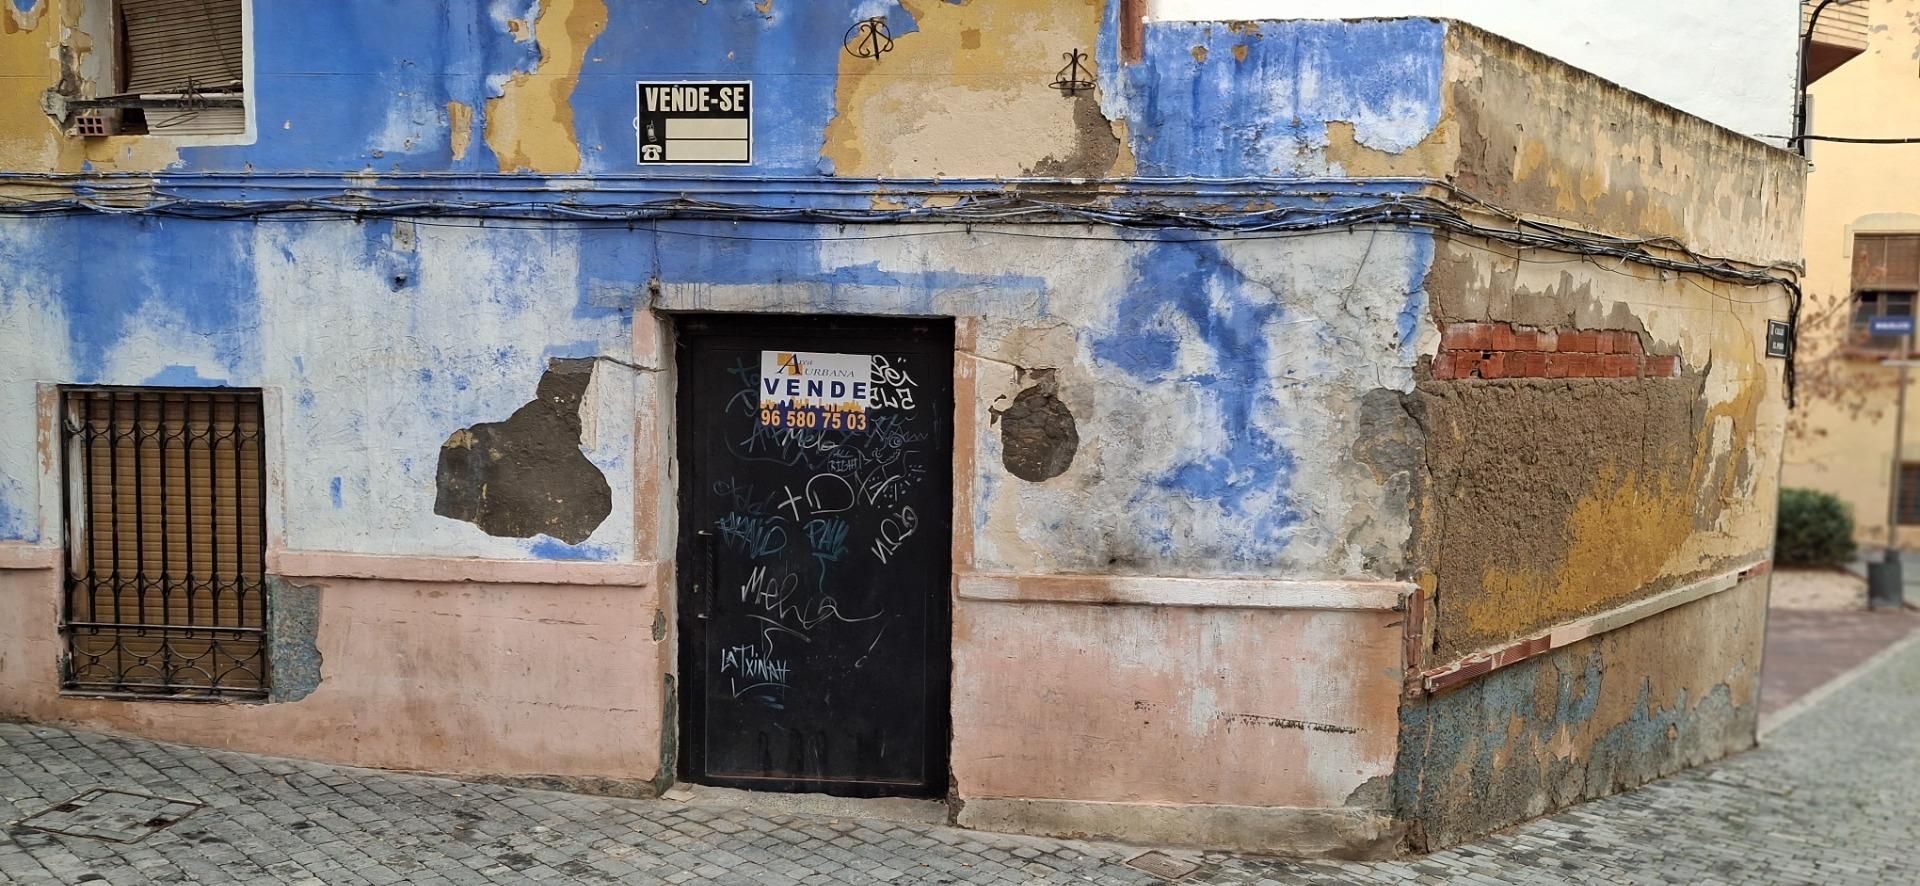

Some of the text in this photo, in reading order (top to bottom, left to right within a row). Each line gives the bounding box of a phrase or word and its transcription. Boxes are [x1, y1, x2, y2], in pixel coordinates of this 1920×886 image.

[645, 86, 745, 112] VENDE-SE
[804, 367, 856, 378] URBANA
[763, 377, 867, 400] VENDE
[761, 409, 781, 427] 96
[786, 410, 816, 428] 580
[822, 412, 842, 430] 75
[846, 413, 867, 431] 03
